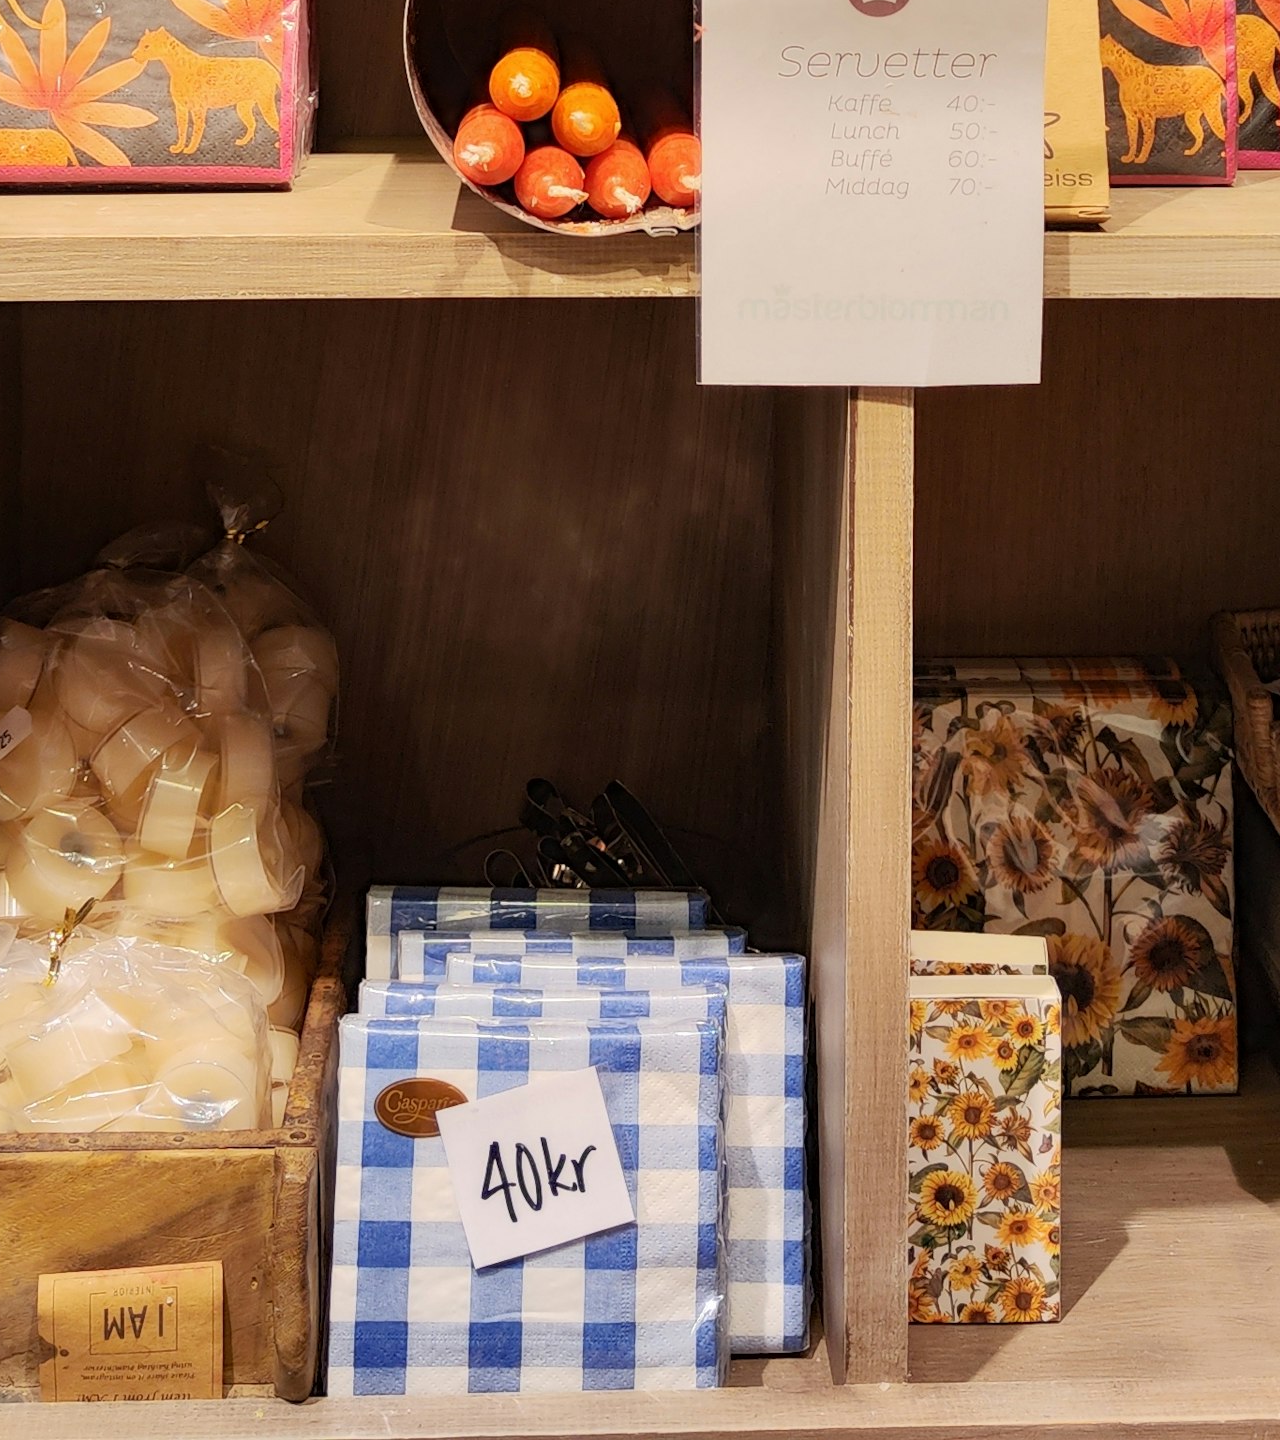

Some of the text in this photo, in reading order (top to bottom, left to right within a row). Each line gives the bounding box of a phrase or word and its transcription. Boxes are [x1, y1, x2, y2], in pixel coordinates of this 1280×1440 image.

[778, 45, 998, 79] Servetter
[946, 94, 997, 113] 40:-
[831, 122, 998, 140] Lunch 50:-
[831, 148, 998, 171] Buffé 60:-
[825, 177, 993, 200] Middag 70:-
[104, 1303, 164, 1341] I AM
